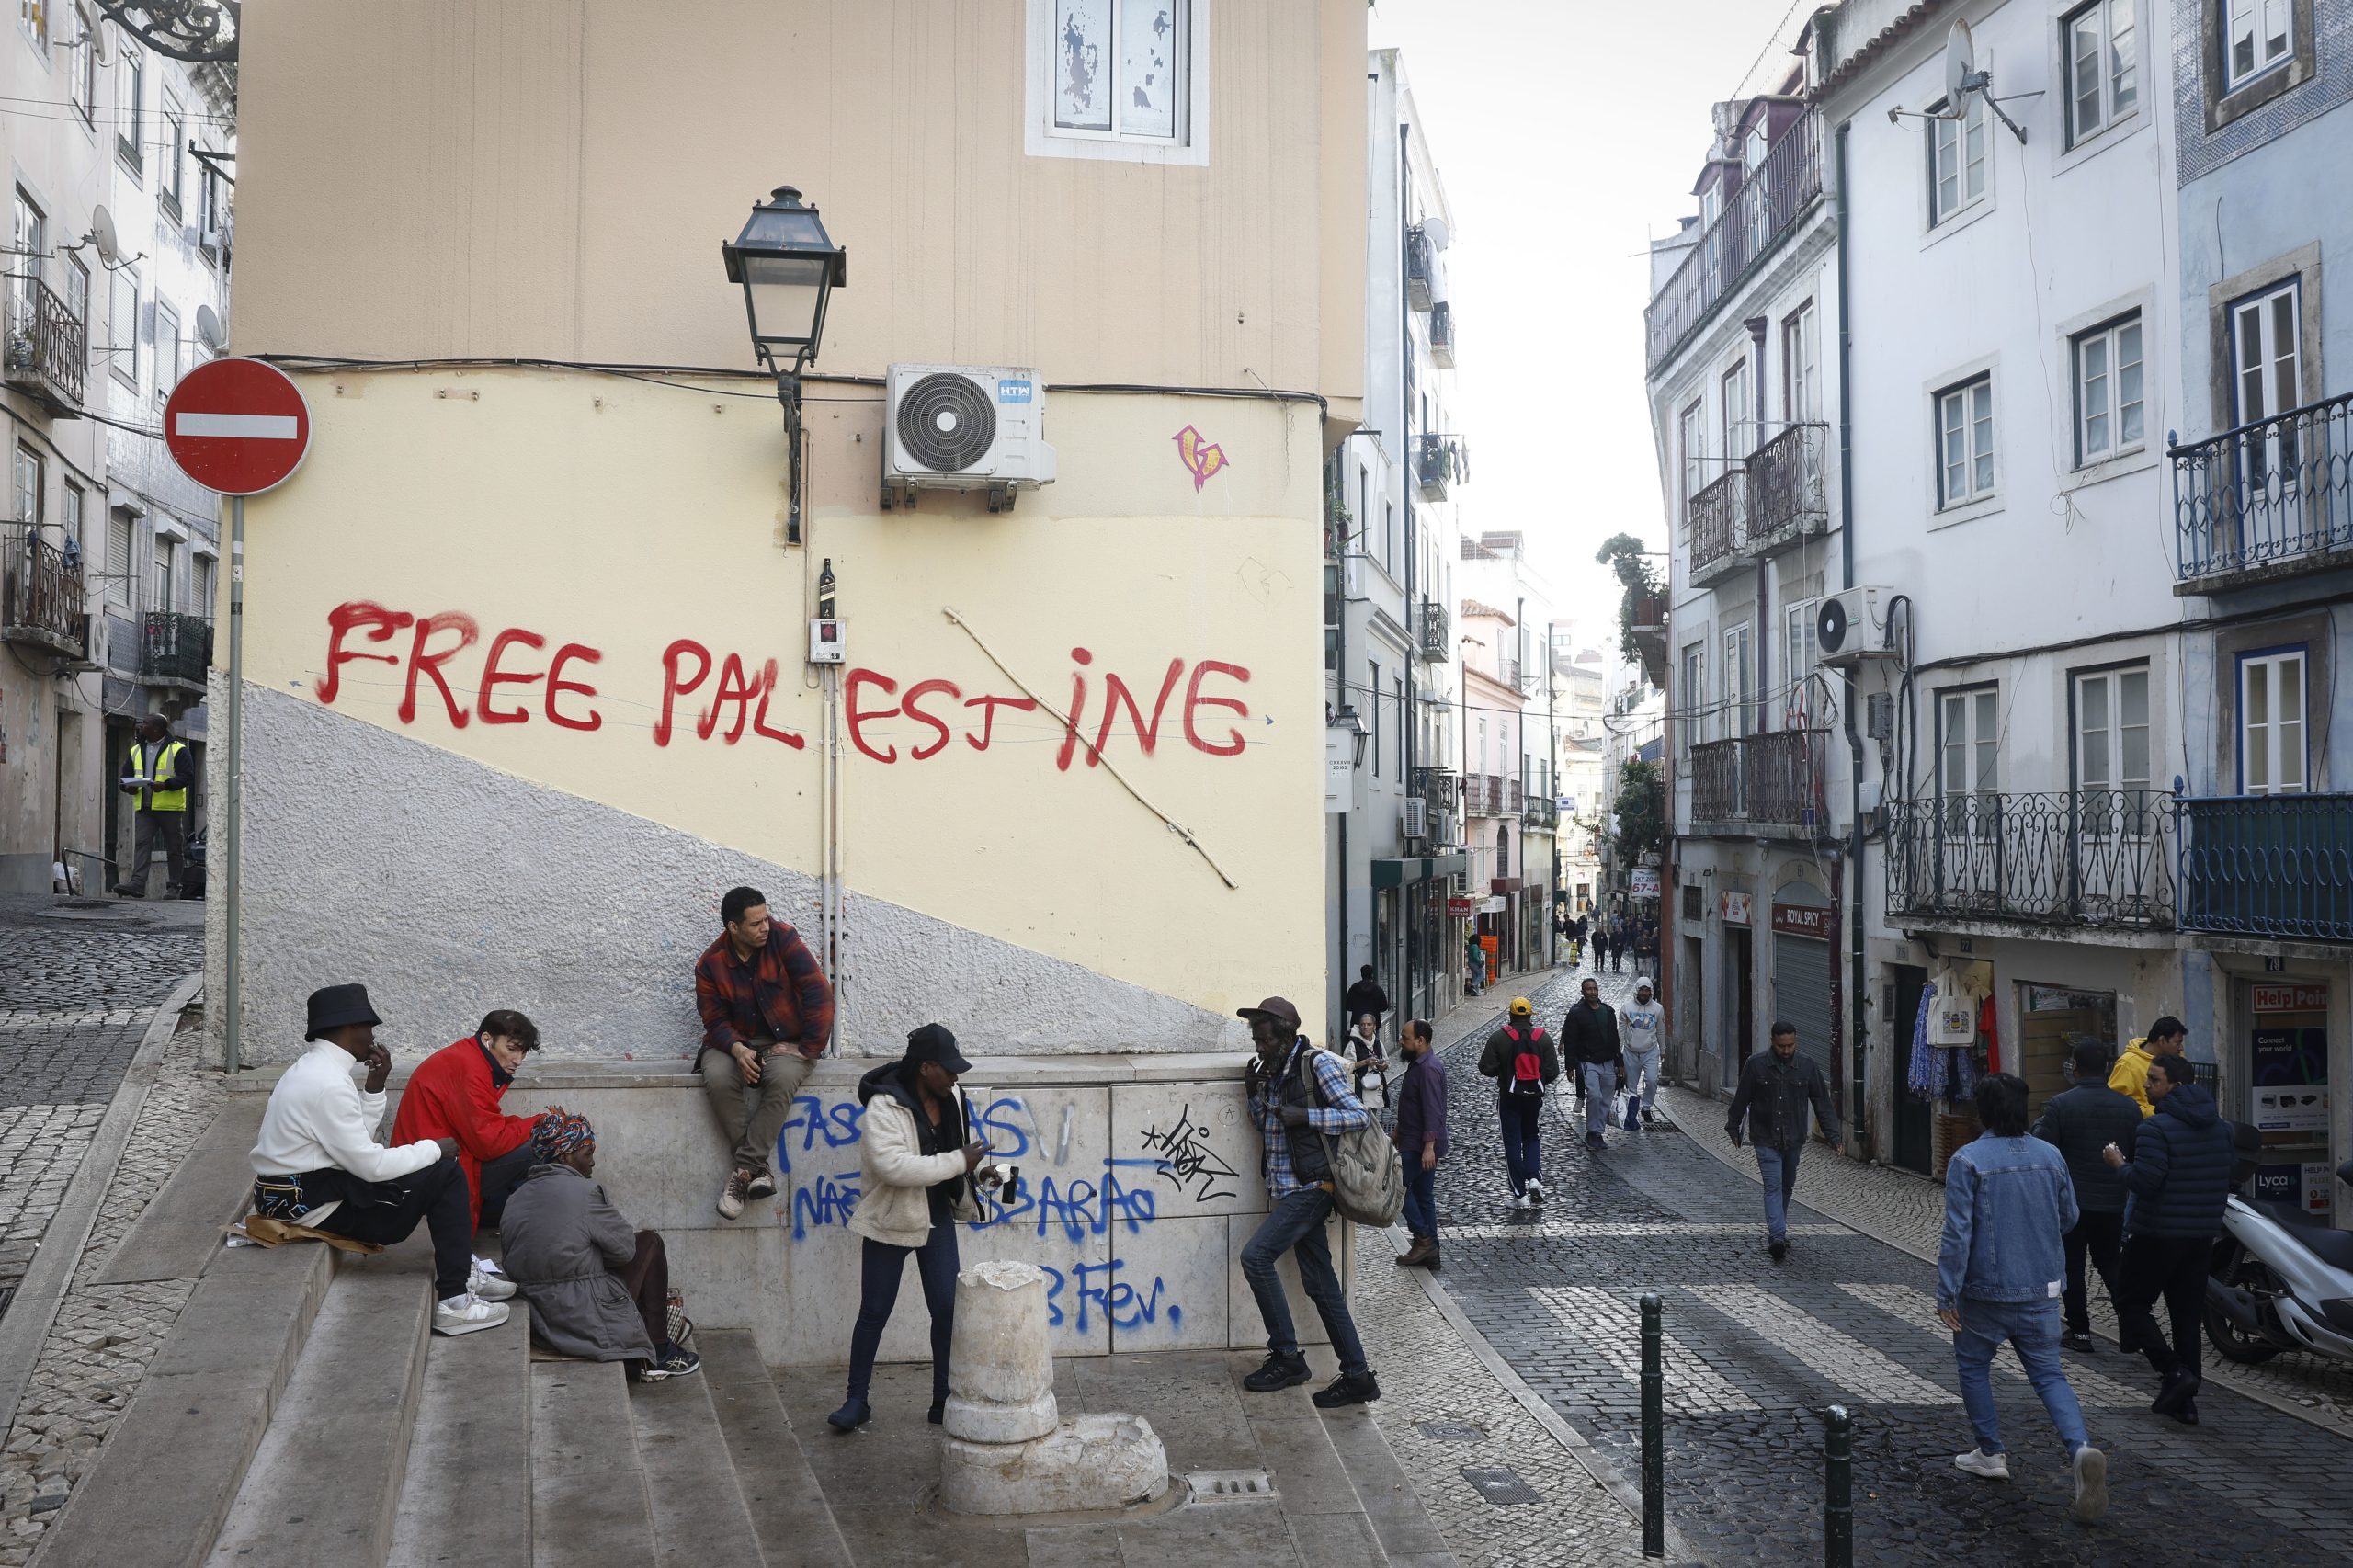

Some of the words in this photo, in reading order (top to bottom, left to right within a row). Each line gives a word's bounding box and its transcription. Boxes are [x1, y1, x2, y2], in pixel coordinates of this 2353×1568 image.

[1000, 386, 1029, 395] HTW
[315, 600, 603, 732] FREE
[1632, 883, 1660, 892] 67-A
[1787, 909, 1804, 925] ROYAL
[1803, 911, 1819, 926] SPICY
[2269, 956, 2280, 971] 79
[2256, 990, 2291, 1008] Help
[2258, 1045, 2273, 1053] your
[2274, 1044, 2292, 1052] world
[2258, 1174, 2289, 1189] Lyca
